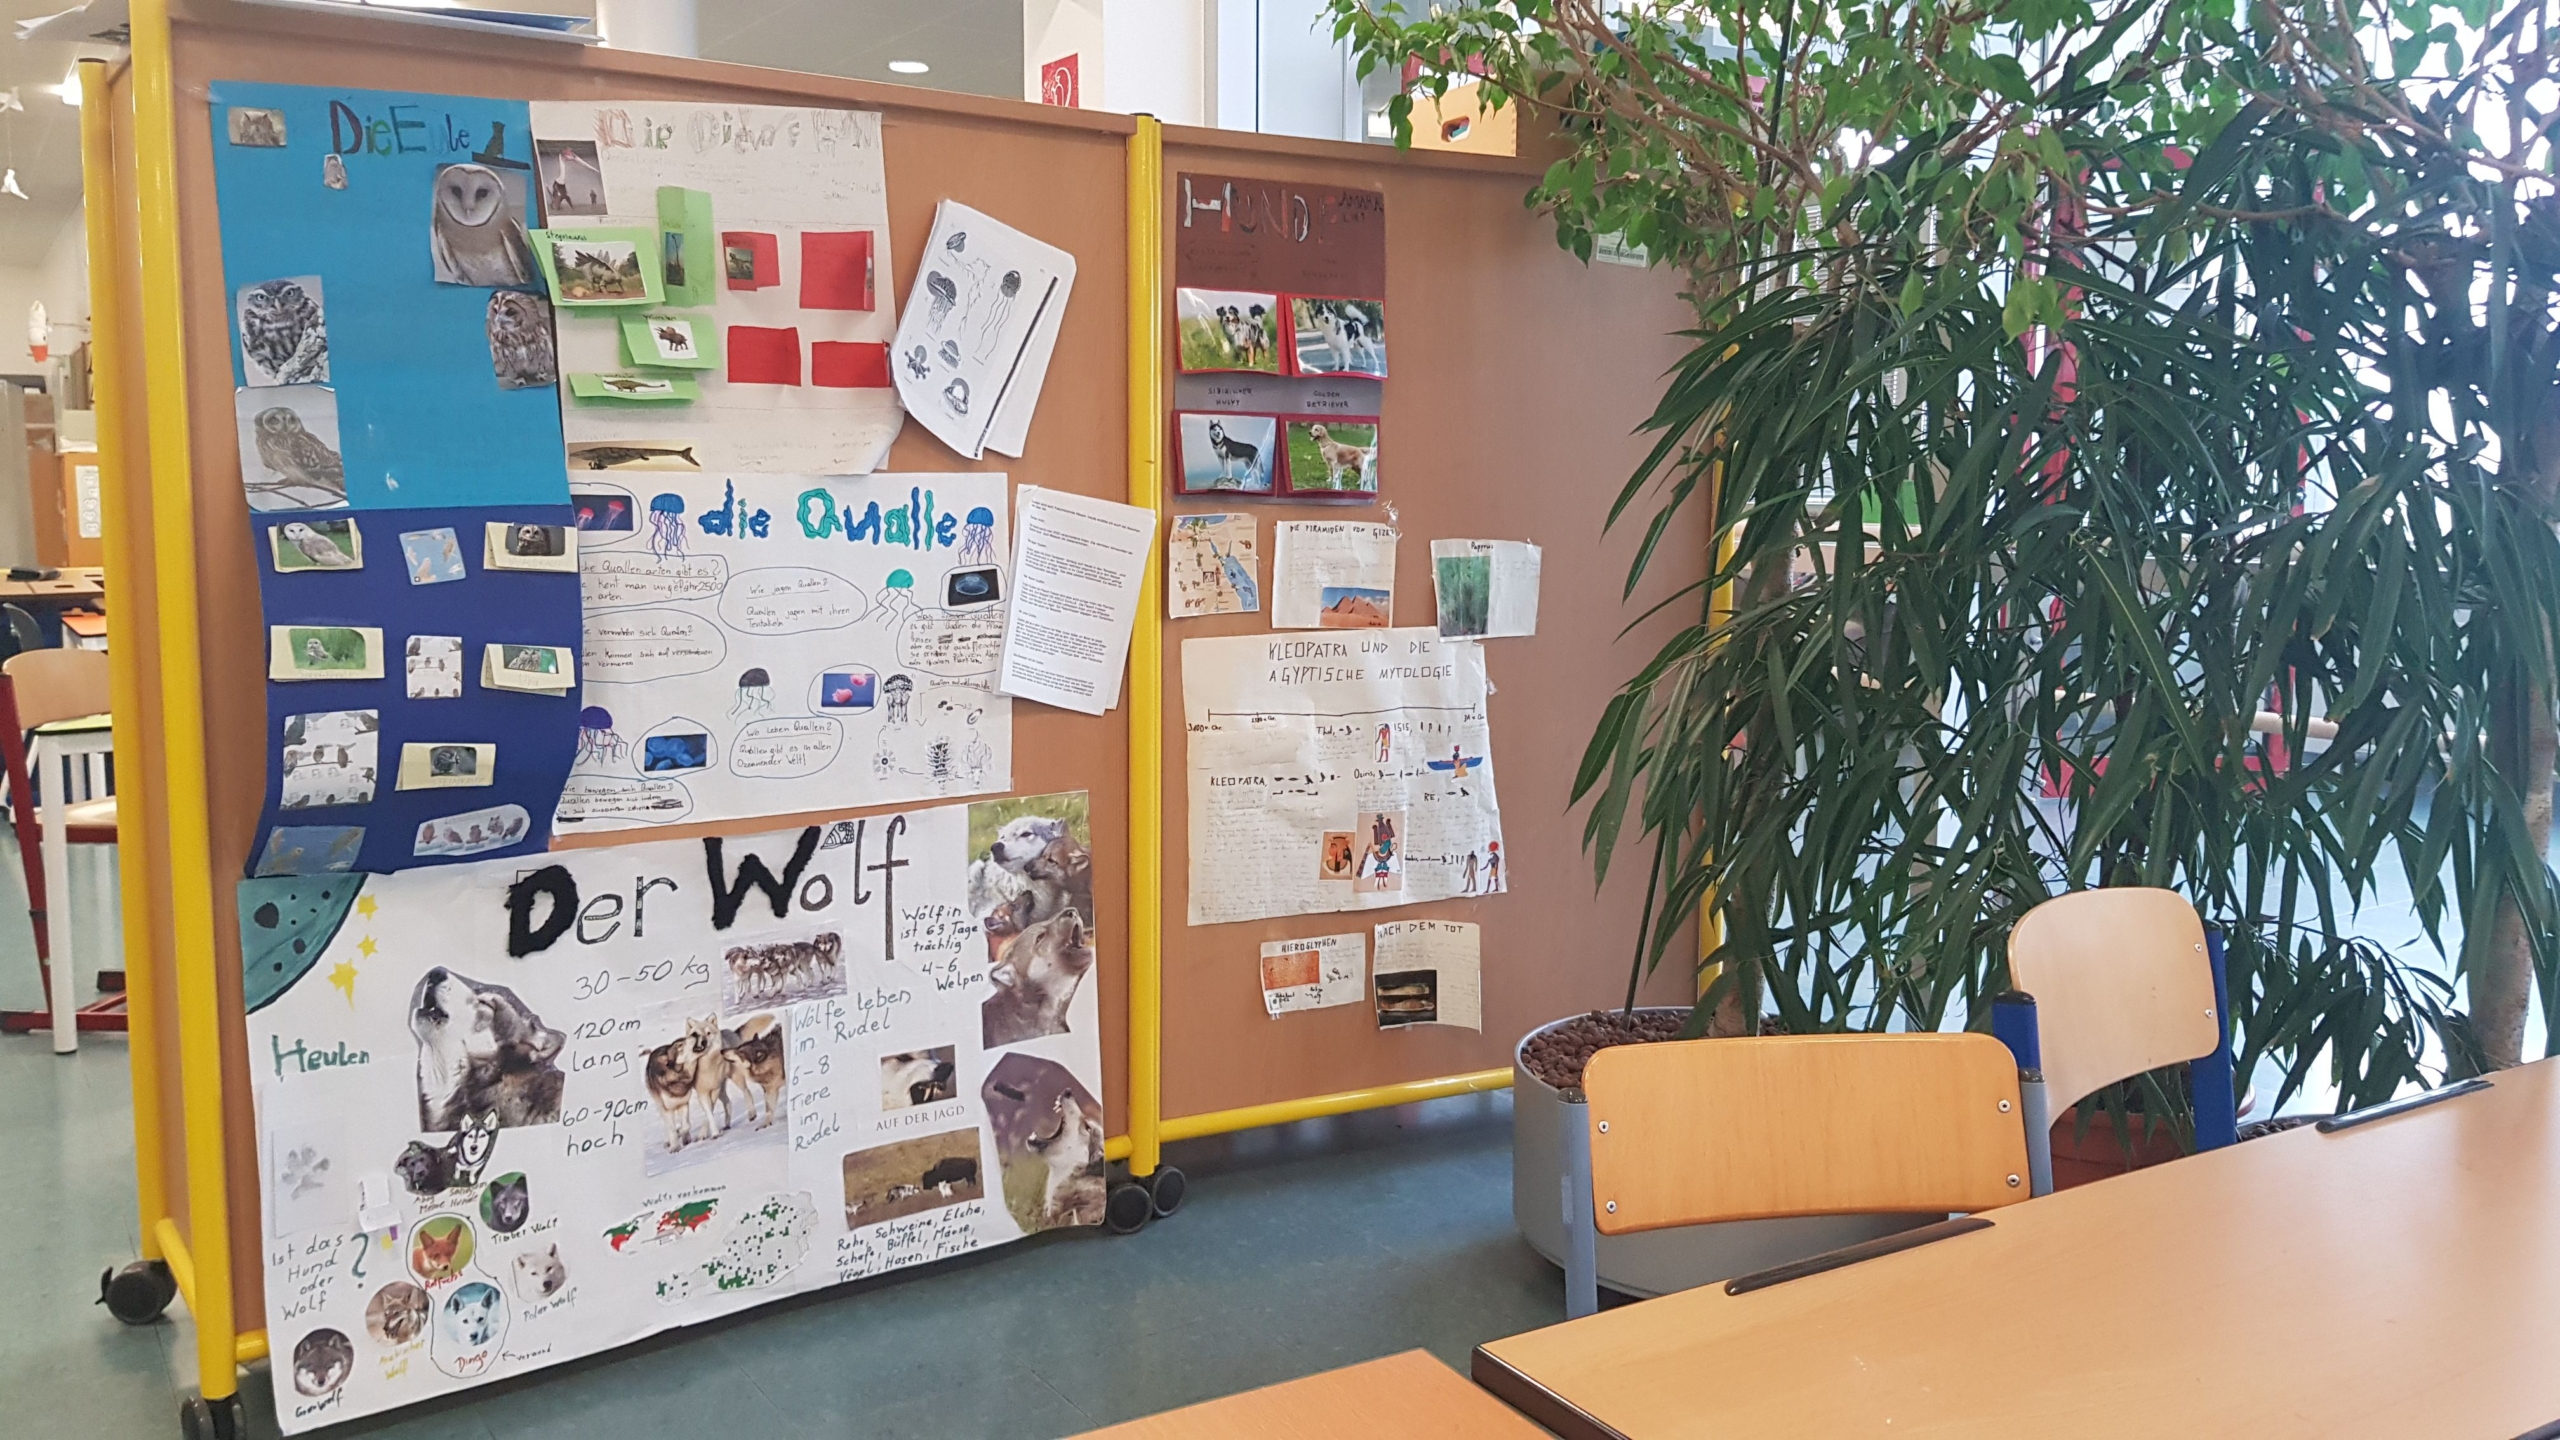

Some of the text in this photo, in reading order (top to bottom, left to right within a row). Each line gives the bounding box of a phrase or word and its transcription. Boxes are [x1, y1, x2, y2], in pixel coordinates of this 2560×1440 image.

[698, 478, 771, 538] die
[797, 486, 957, 551] Qualle
[1269, 641, 1430, 661] KLEOPATRA UND DIE
[1379, 665, 1452, 679] MYTOLOGIE
[506, 816, 909, 960] Der Wolf
[901, 920, 918, 940] ist
[951, 921, 978, 940] Tage
[1409, 922, 1436, 933] DEM
[1444, 924, 1464, 933] TOT
[681, 955, 710, 990] kg
[935, 970, 984, 991] Welpen
[857, 986, 912, 1012] leben
[834, 1006, 891, 1044] Rudel
[271, 1034, 371, 1077] Heulen
[573, 1050, 629, 1079] lang
[789, 1086, 831, 1112] Tiere
[800, 1111, 819, 1126] im
[875, 1105, 966, 1132] AUF DER JAGD
[567, 1121, 624, 1156] hoch
[794, 1112, 841, 1152] Rudel
[306, 1234, 343, 1255] das
[288, 1248, 338, 1283] Hund
[300, 1274, 333, 1295] oder
[281, 1290, 327, 1321] Wolf
[454, 1350, 488, 1373] Dingo
